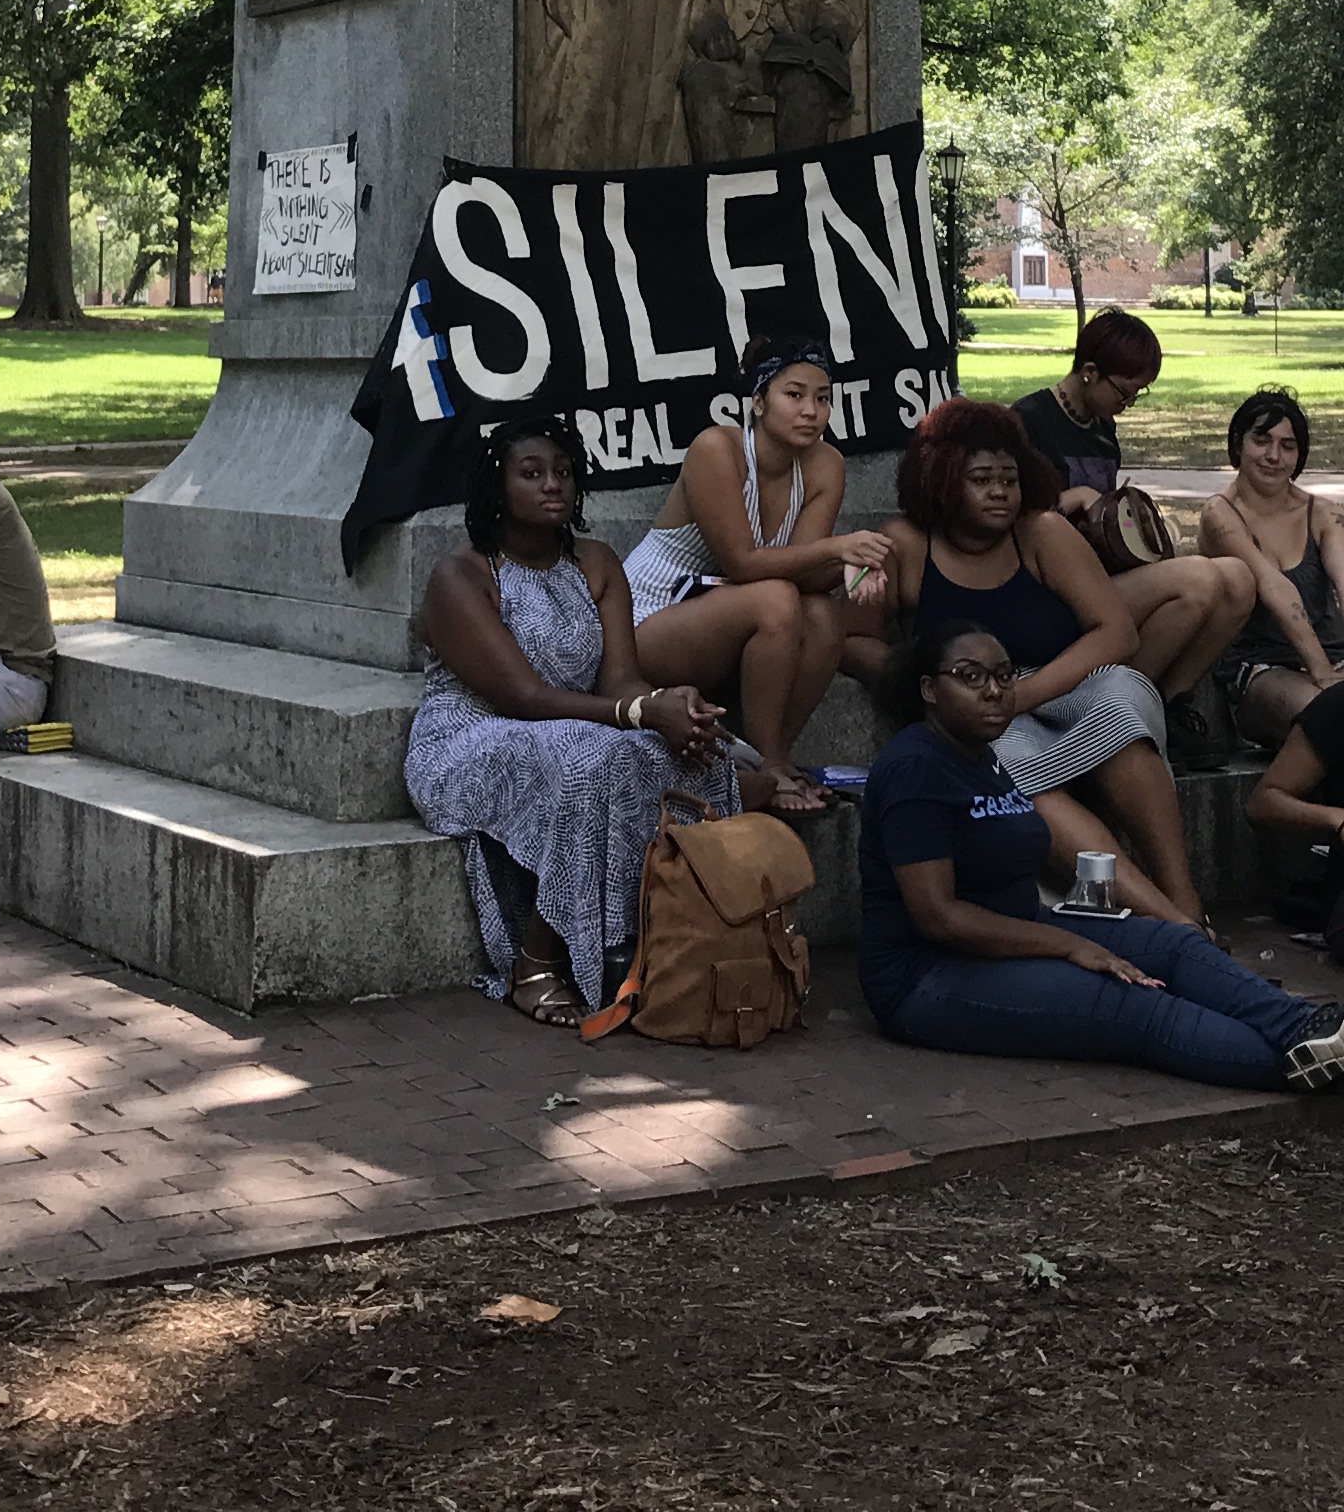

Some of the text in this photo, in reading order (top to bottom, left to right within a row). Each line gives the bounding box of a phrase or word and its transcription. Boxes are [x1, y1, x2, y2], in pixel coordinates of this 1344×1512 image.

[267, 155, 331, 188] THERE IS
[278, 192, 328, 219] NOTHING
[280, 219, 323, 246] SILENT
[261, 249, 296, 275] ABOUT
[432, 149, 949, 402] SILEN
[575, 402, 691, 475] REAL
